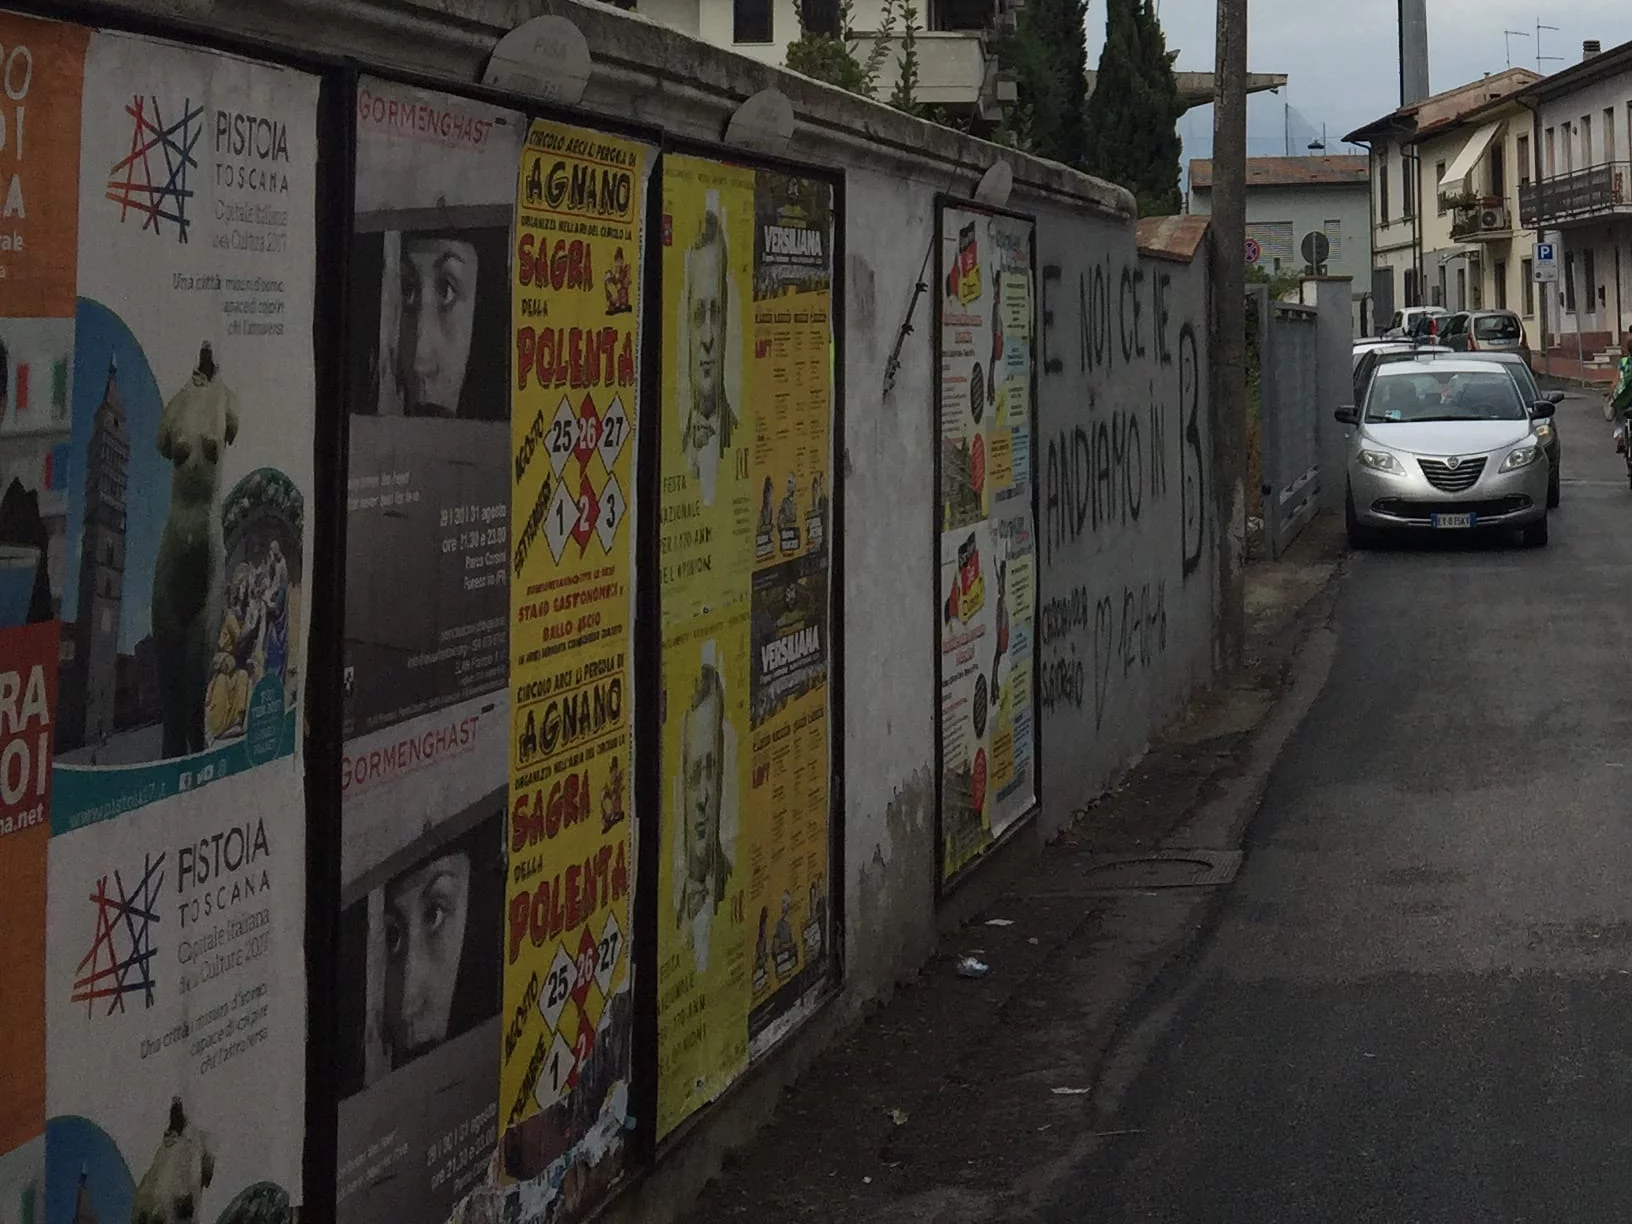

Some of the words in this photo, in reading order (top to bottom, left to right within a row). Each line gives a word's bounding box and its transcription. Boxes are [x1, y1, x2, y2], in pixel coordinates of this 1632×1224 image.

[0, 43, 33, 100] O
[215, 110, 289, 163] PISTOIA
[359, 88, 494, 144] GORMENGHAST
[215, 163, 289, 194] TOSCANA
[525, 156, 632, 216] AGNANO
[518, 233, 594, 292] SAGRA
[1540, 246, 1550, 258] P
[521, 299, 549, 317] DELLA
[1042, 264, 1063, 376] E
[516, 325, 635, 391] POLENTA
[551, 420, 573, 454] 25
[577, 417, 597, 449] 26
[603, 416, 624, 448] 27
[1047, 389, 1141, 568] ANDIAMO
[555, 498, 565, 536] 1
[578, 495, 590, 532] 2
[606, 493, 616, 529] 3
[662, 499, 700, 524] AZIONALE
[542, 621, 573, 642] BALLO
[518, 677, 622, 764] AGNANO
[341, 716, 480, 791] GORMENGHAST
[512, 769, 590, 853] SAGRA
[178, 816, 271, 894] PISTOIA
[514, 853, 544, 884] DELLA
[178, 869, 271, 930] TOSCANA
[510, 839, 628, 966] POLENTA
[547, 964, 569, 1009] 25
[576, 946, 595, 982] 26
[599, 932, 619, 972] 27
[549, 1052, 560, 1092] 1
